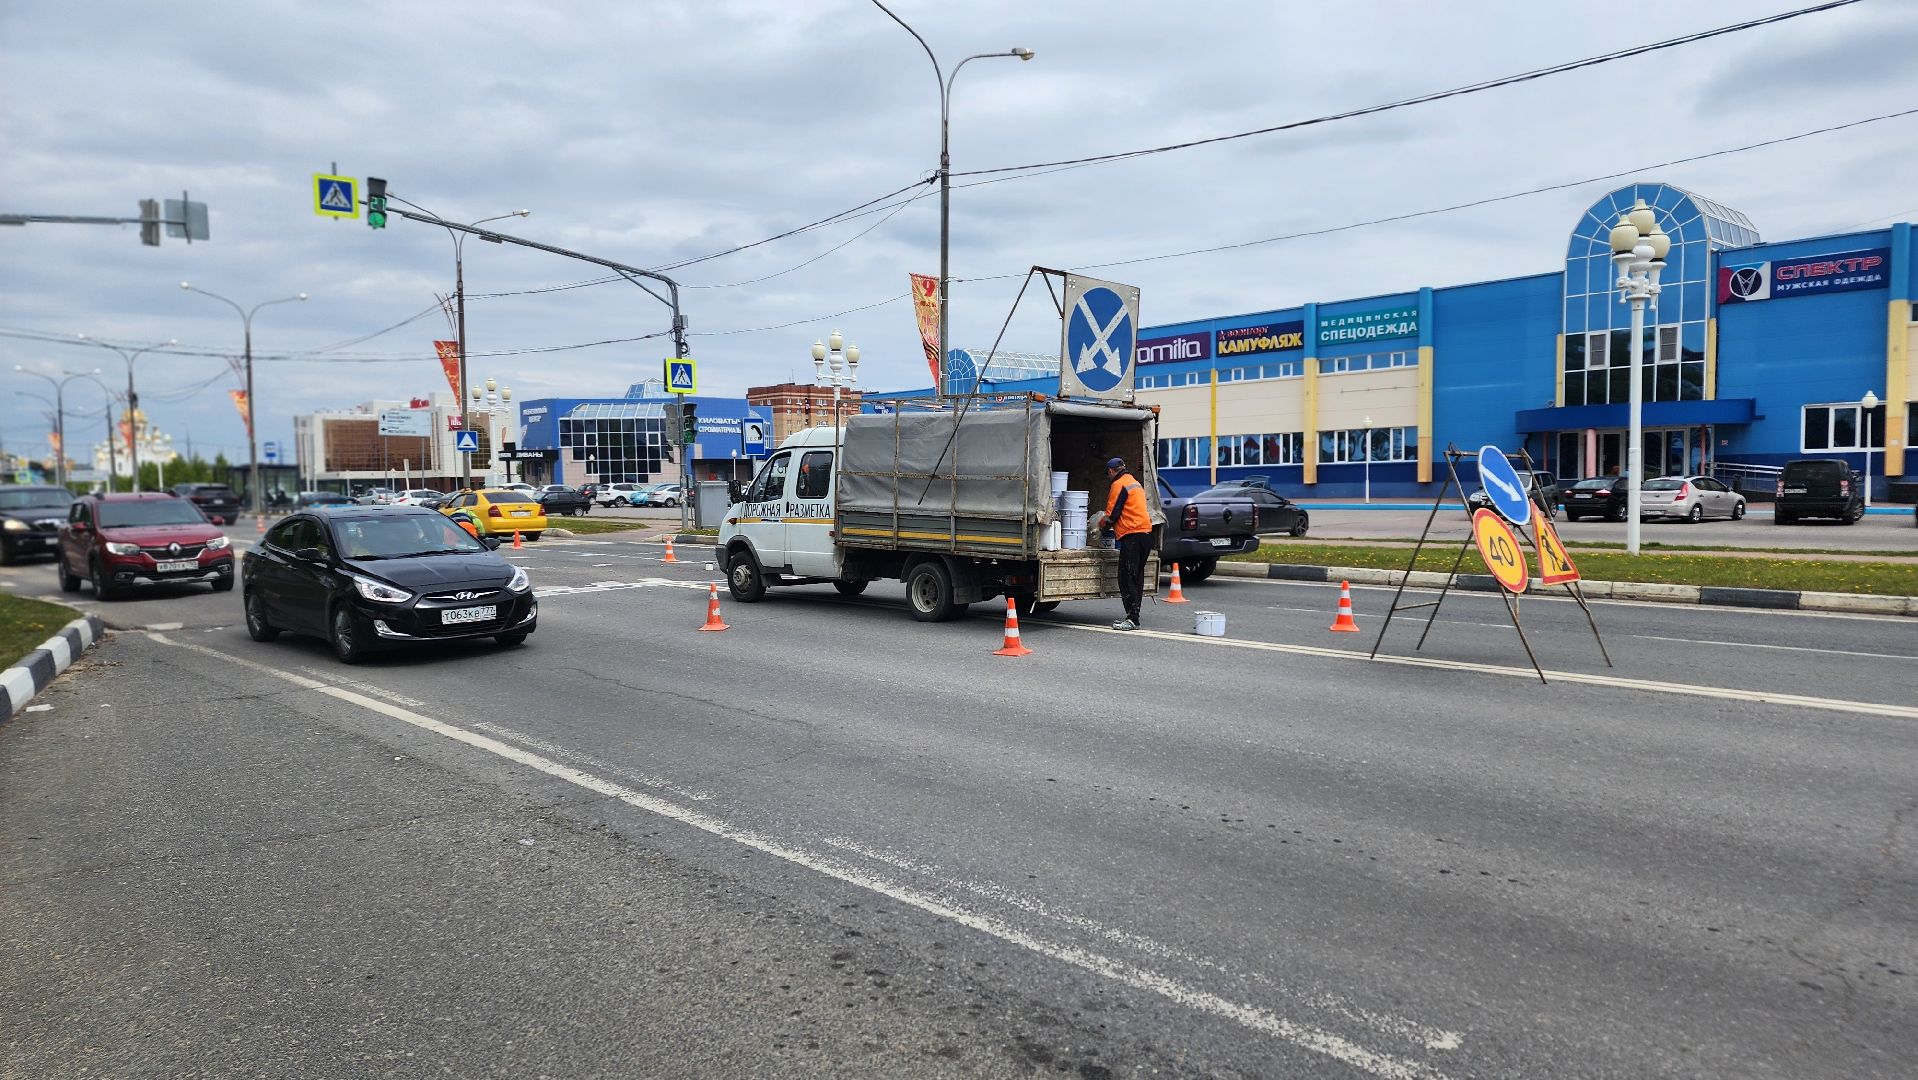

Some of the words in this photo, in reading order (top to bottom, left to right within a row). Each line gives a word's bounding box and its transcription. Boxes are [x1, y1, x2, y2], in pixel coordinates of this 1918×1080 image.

[1776, 255, 1883, 281] СПЕКТР
[922, 279, 936, 298] 9
[1776, 279, 1830, 291] МУЖСКАЯ
[1833, 274, 1882, 285] ОДЕЖДА
[1320, 309, 1418, 327] МЕДИЦИНСКАЯ
[1320, 321, 1418, 341] СПЕЦОДЕЖДА
[1136, 337, 1202, 364] amilia
[1218, 332, 1303, 355] КАМУФЛЯЖ
[743, 503, 781, 518] ДОРОЖНАЯ
[789, 503, 831, 518] РАЗМЕТКА
[1489, 535, 1515, 567] 40
